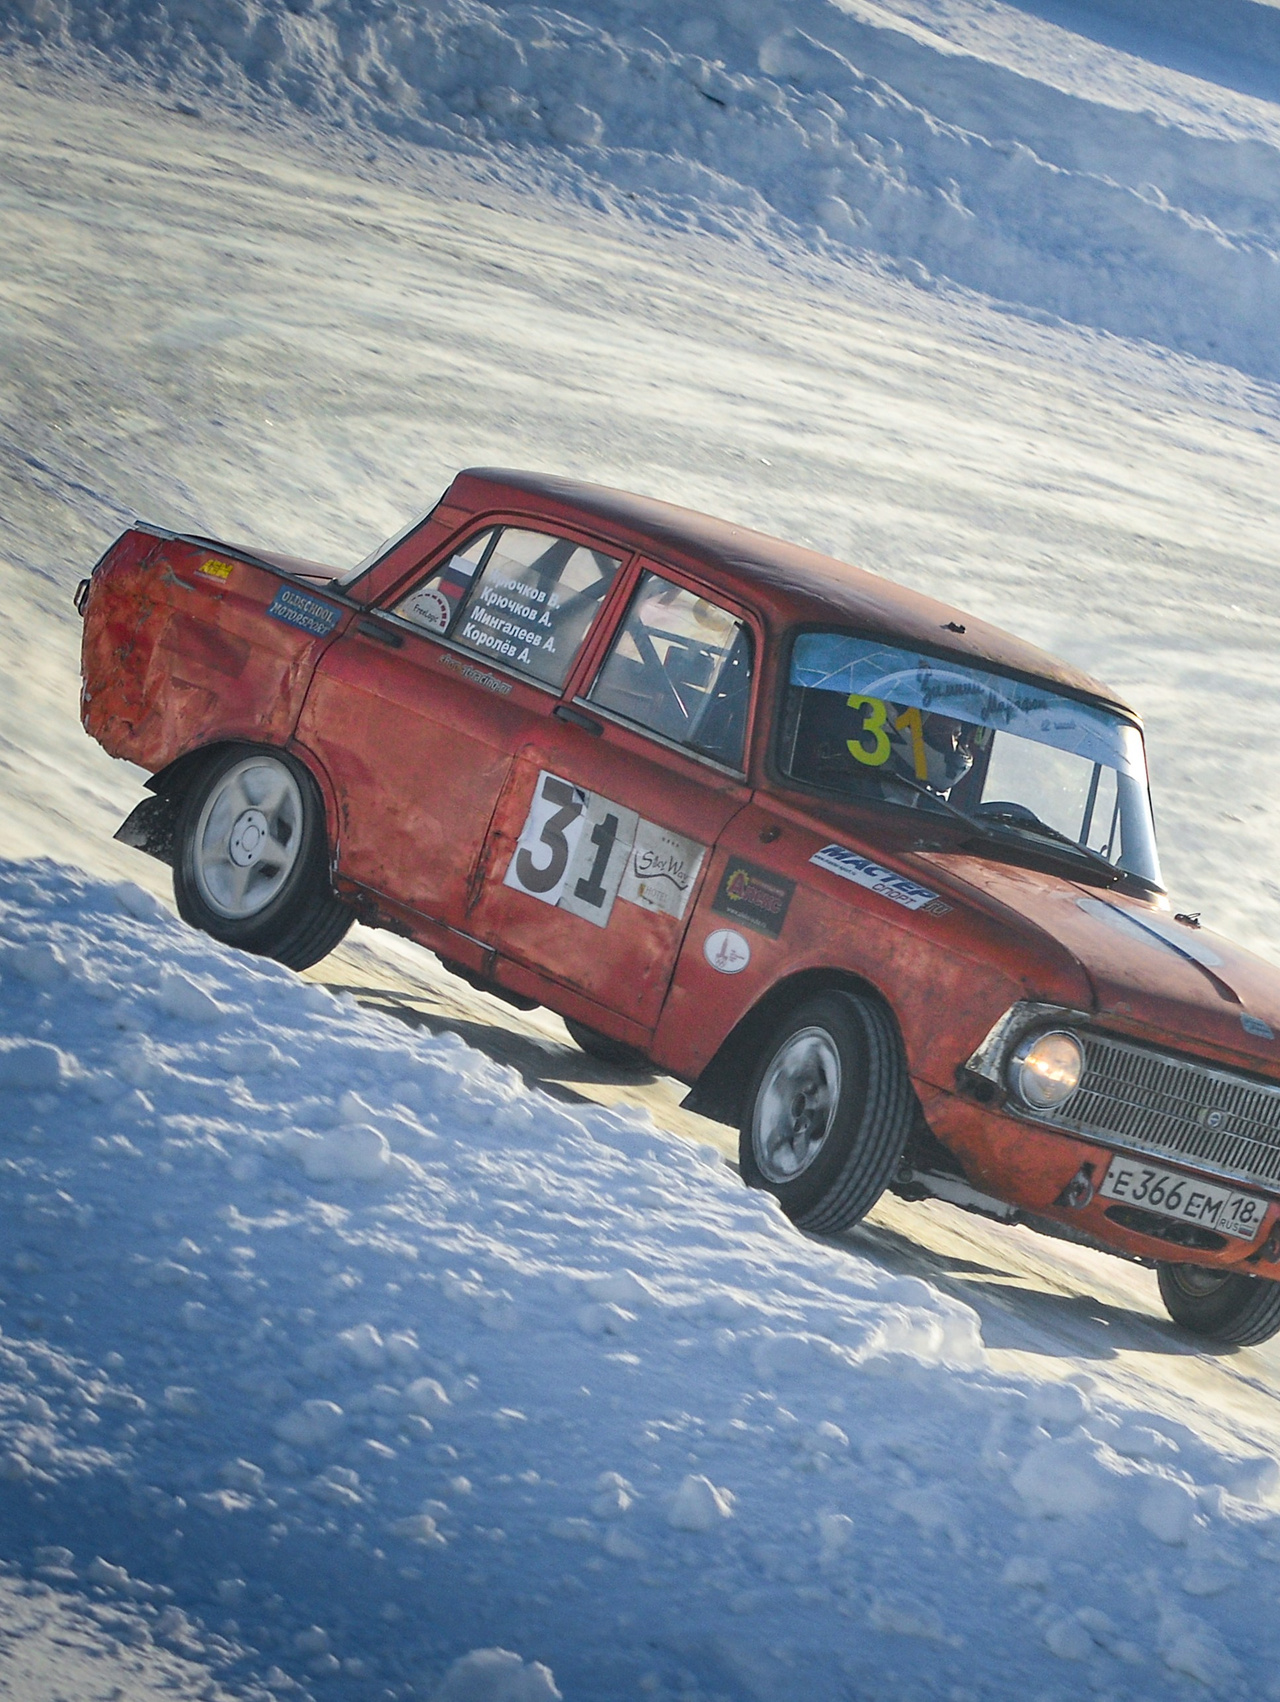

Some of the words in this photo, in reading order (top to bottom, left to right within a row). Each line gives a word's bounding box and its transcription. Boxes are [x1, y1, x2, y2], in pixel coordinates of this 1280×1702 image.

[269, 602, 331, 635] MOTORSPORT
[281, 590, 335, 623] OLDSCHOOL
[480, 586, 537, 620] Крючков
[538, 611, 553, 627] А.
[462, 622, 516, 658] Королёв
[517, 648, 531, 664] А.
[470, 605, 542, 647] Мингалеев
[543, 636, 556, 653] А.
[845, 693, 928, 781] 31
[515, 775, 619, 909] 31
[819, 844, 941, 901] МАСТЕР
[872, 881, 917, 907] СПОРТ
[1219, 1218, 1240, 1232] RUS
[1230, 1199, 1257, 1223] 18
